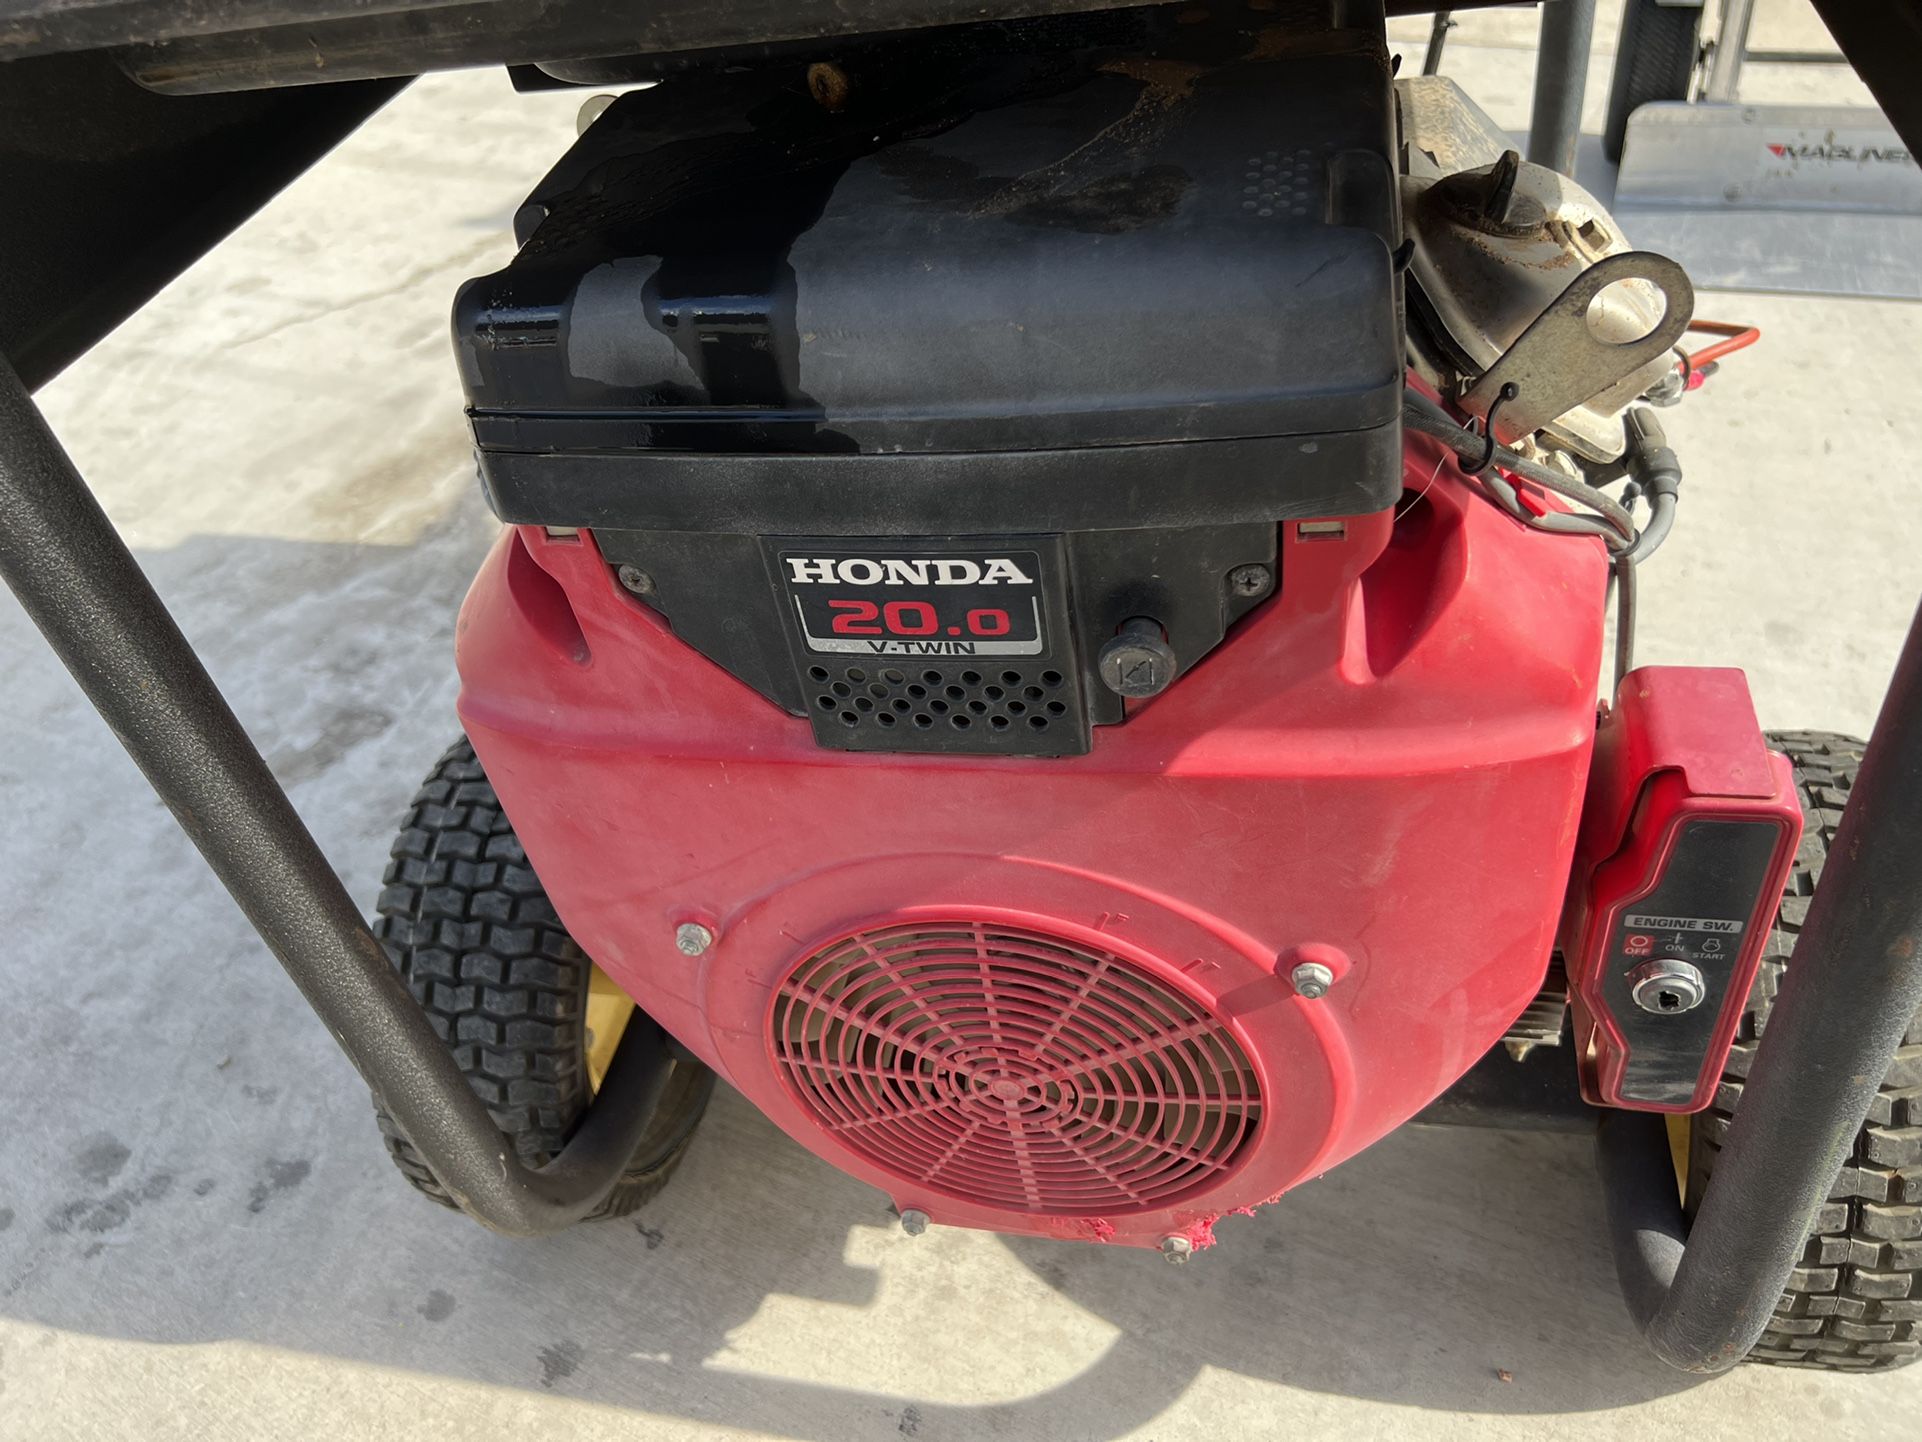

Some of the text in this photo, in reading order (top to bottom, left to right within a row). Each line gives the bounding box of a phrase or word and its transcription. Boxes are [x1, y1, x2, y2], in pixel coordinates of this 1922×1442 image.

[786, 558, 1033, 586] HONDA
[828, 600, 1010, 636] 20.0
[867, 641, 976, 655] V-TWIN
[1634, 917, 1733, 931] ENGINE SW.
[1624, 944, 1726, 961] OFF ON START
